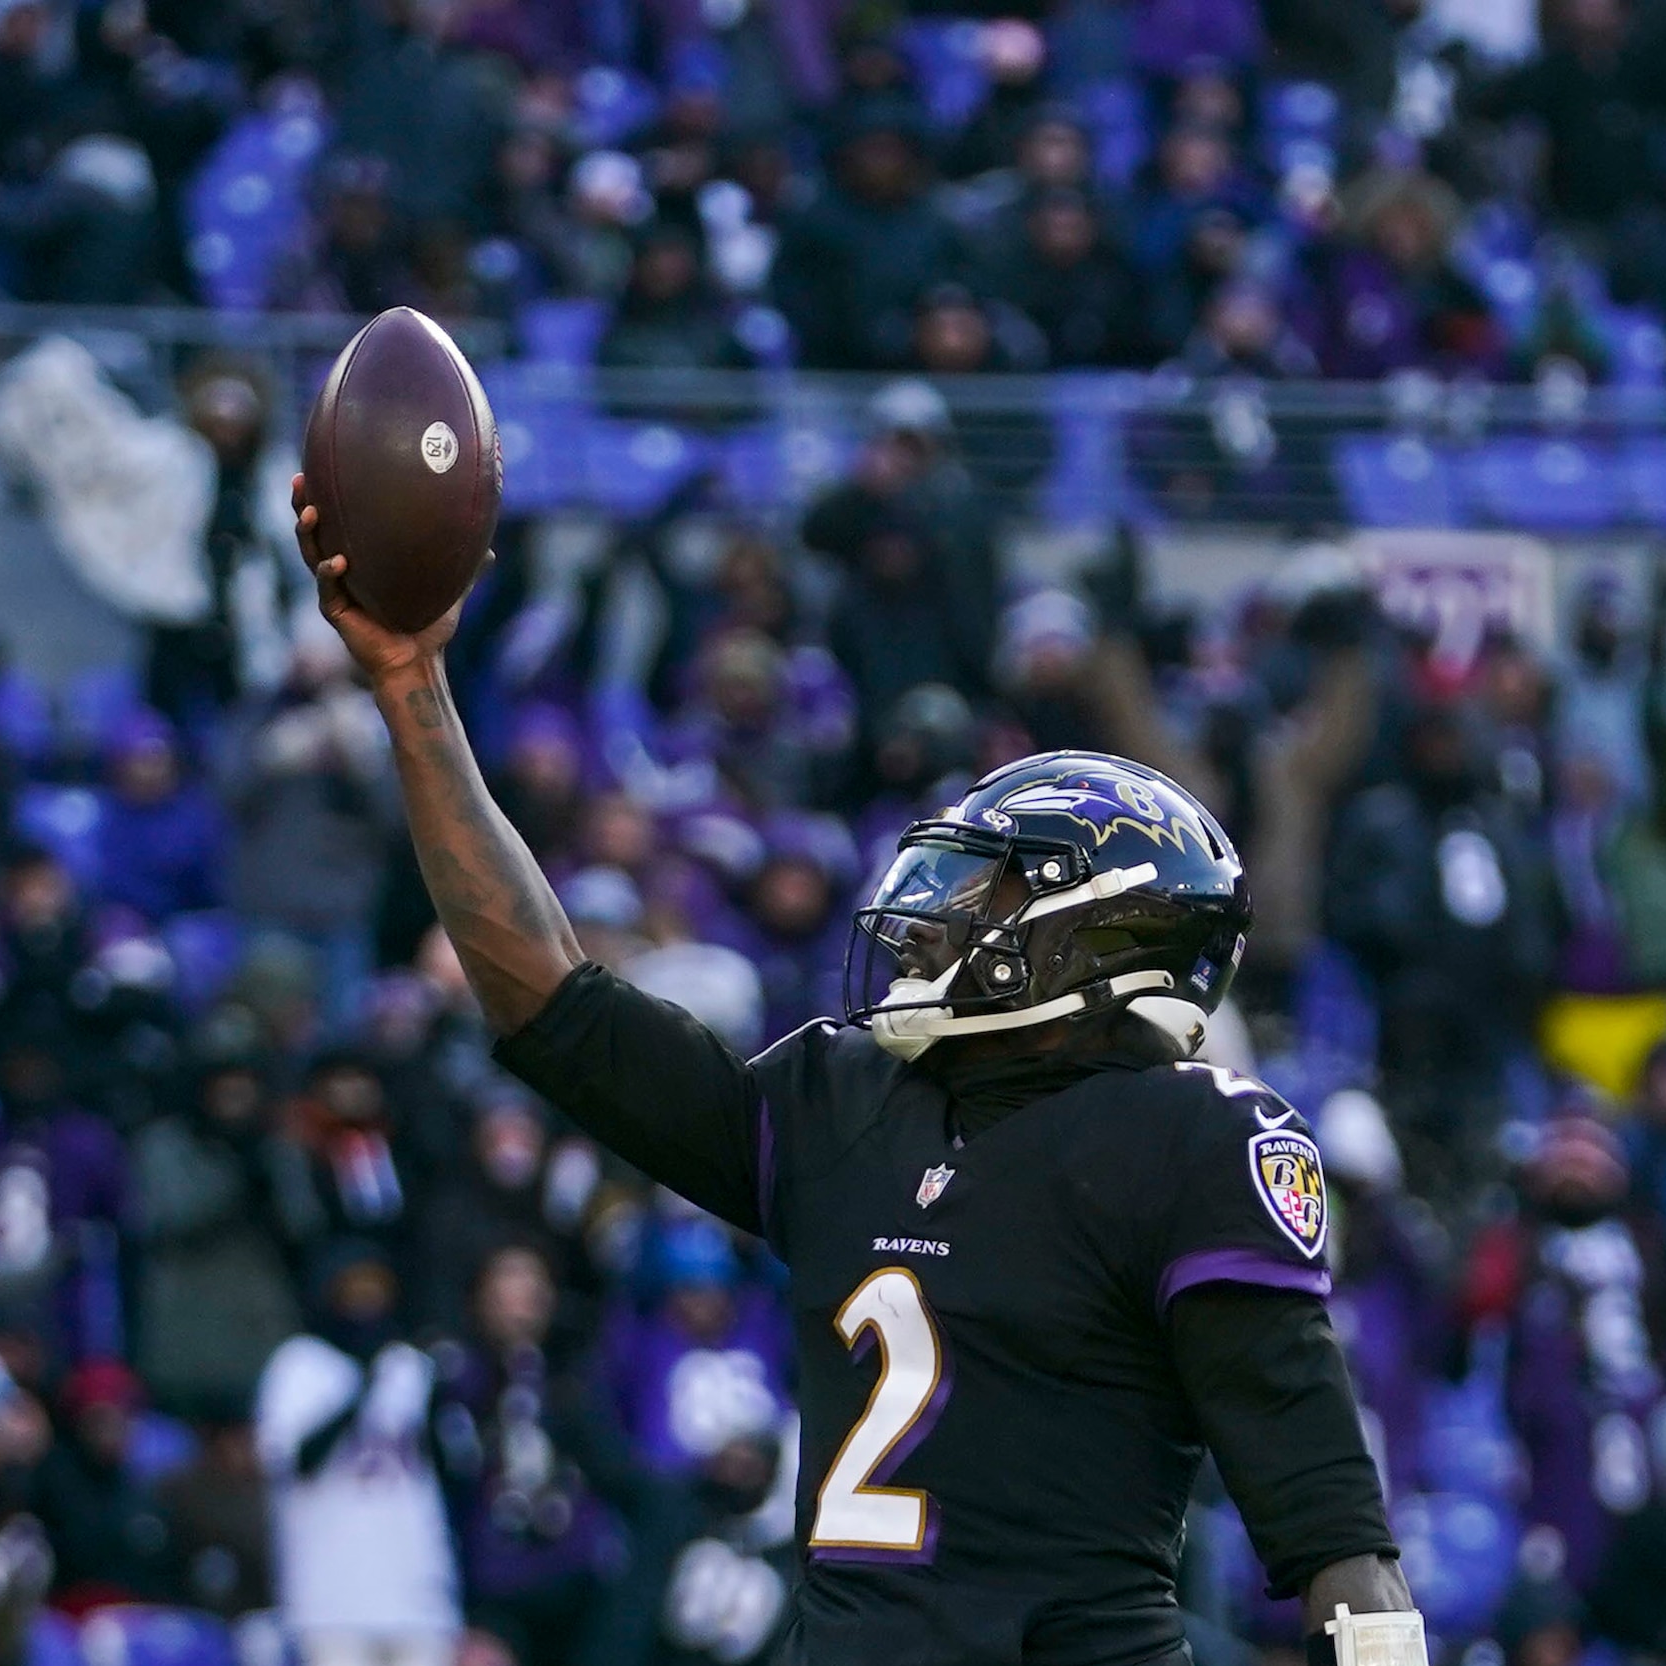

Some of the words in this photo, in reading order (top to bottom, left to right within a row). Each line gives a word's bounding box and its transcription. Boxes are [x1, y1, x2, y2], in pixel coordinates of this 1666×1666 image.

[426, 436, 442, 458] 129
[1259, 1140, 1315, 1162] RAVENS
[872, 1237, 951, 1256] RAVENS
[808, 1266, 951, 1560] 2
